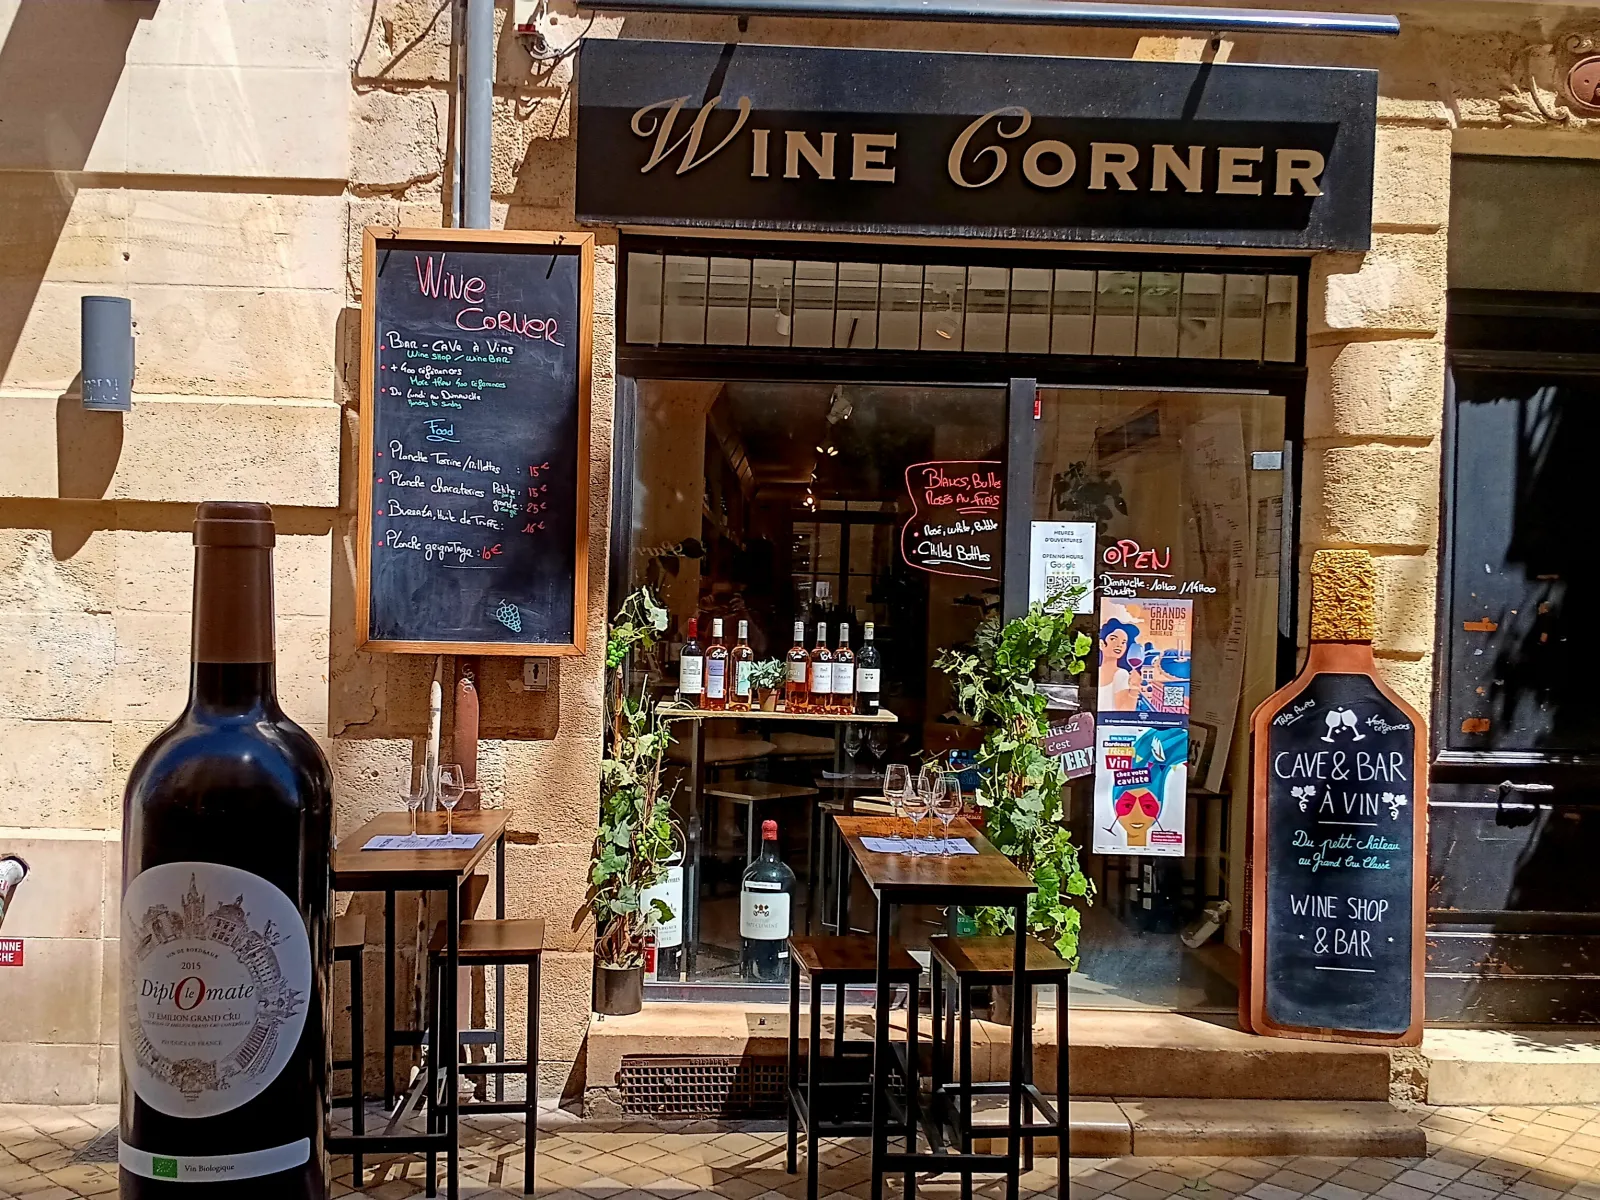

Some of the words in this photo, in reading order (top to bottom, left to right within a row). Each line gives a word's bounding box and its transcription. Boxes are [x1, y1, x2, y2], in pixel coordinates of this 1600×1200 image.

[630, 95, 898, 184] WINE
[947, 105, 1325, 197] CORNER
[423, 418, 454, 436] Food
[1103, 540, 1170, 570] OPEN
[1050, 560, 1076, 570] Google
[1150, 606, 1187, 619] GRANDS
[1149, 618, 1174, 631] CRUS
[1045, 721, 1080, 738] ntrez
[1048, 739, 1072, 752] c'est
[1108, 756, 1129, 768] Vin
[1275, 752, 1329, 781] CAVE
[1331, 751, 1349, 781] &
[1357, 752, 1407, 782] BAR
[1117, 776, 1149, 785] caviste
[1343, 791, 1379, 816] VIN
[1292, 829, 1315, 848] Du
[1320, 833, 1355, 858] petit
[1357, 834, 1400, 850] château
[1298, 857, 1312, 866] au
[1290, 894, 1338, 919] WINE
[1347, 897, 1389, 923] SHOP
[1314, 926, 1329, 955] &
[1335, 928, 1373, 957] BAR
[0, 952, 14, 962] HE
[186, 947, 219, 959] BORDEAUX
[181, 961, 202, 970] 2015
[184, 987, 195, 998] le
[156, 1013, 189, 1022] EMILION
[190, 1013, 222, 1022] GRAND
[222, 1011, 241, 1021] CRU
[184, 1164, 197, 1172] Vin
[198, 1164, 235, 1173] Biologique
